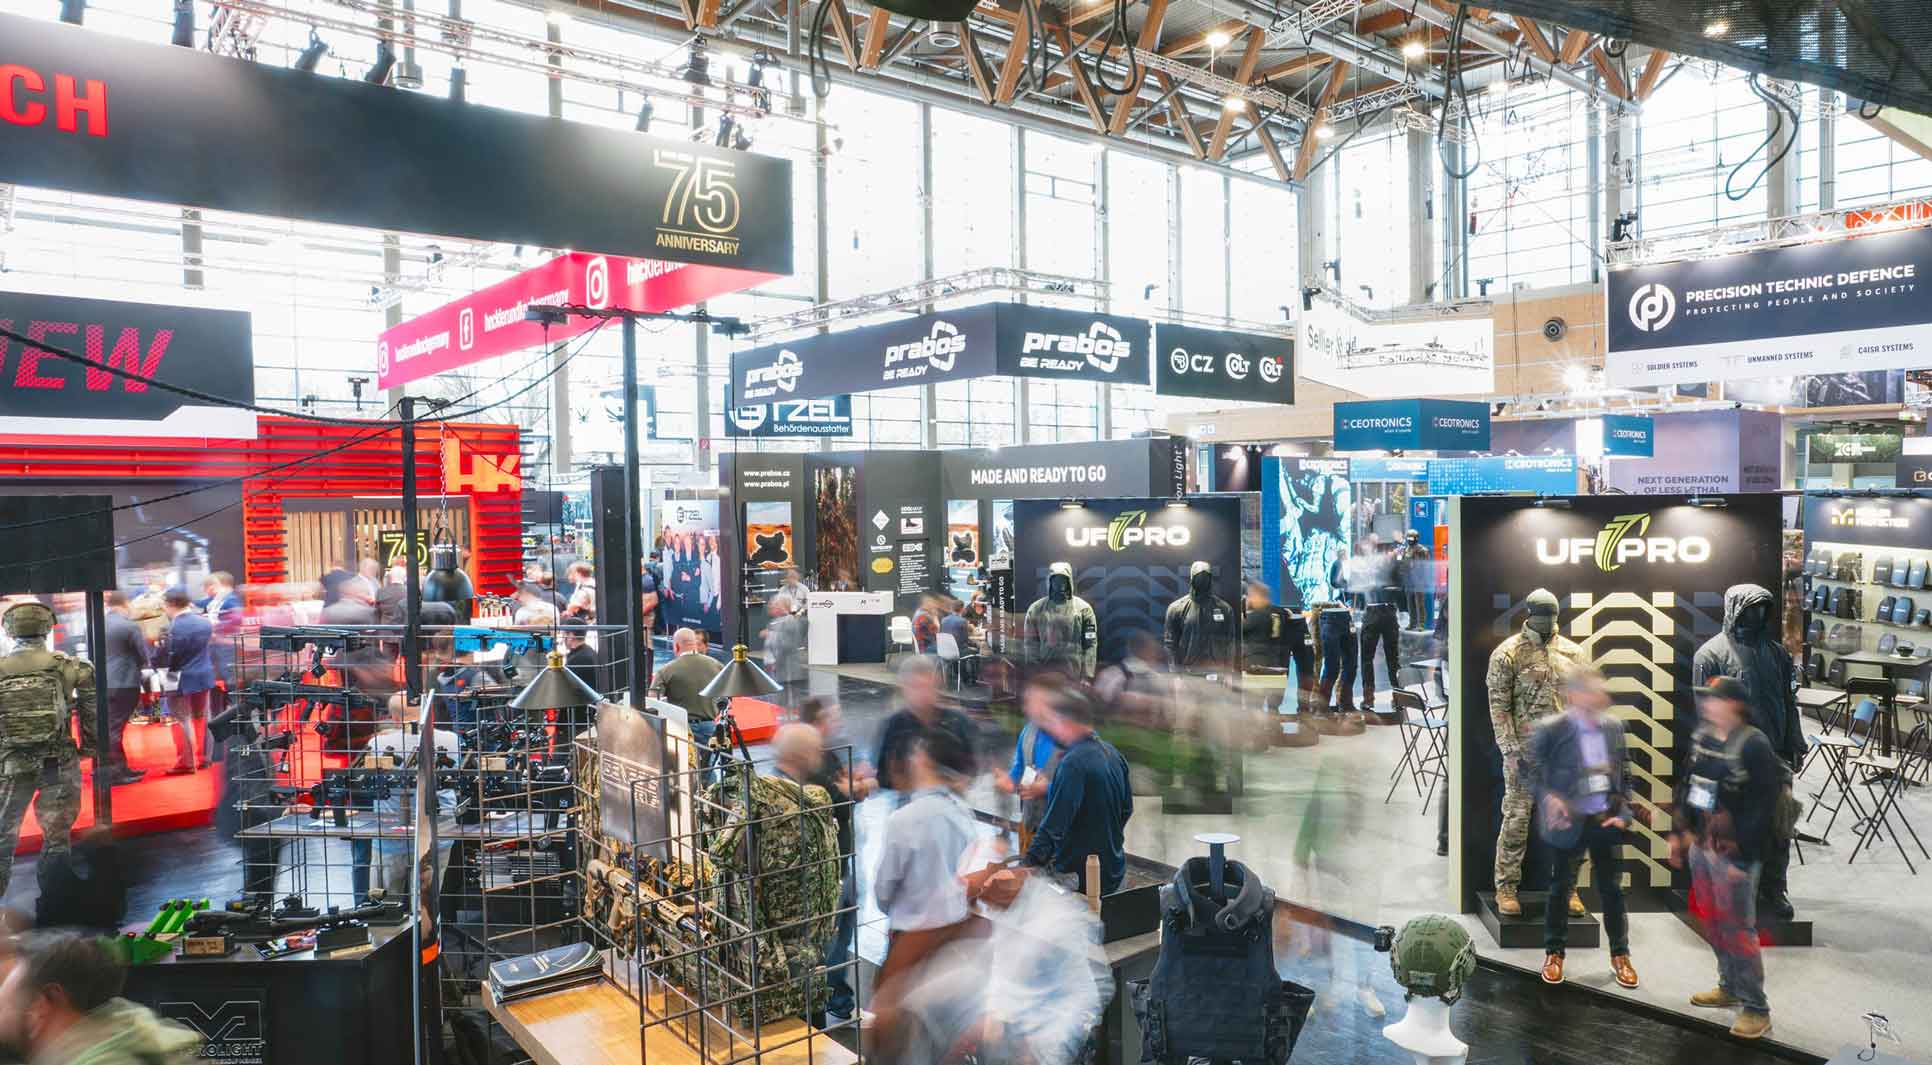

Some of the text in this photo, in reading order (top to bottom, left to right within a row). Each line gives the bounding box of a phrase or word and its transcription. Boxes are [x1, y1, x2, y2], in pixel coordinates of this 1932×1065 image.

[652, 150, 740, 233] 75
[656, 233, 740, 256] ANNIVERSARY
[1686, 264, 1915, 303] PRECISION TECHNIC DEFENCE
[1686, 284, 1914, 316] PROTECTING PEOPLE AND SOCIETY
[884, 334, 967, 367] prabos
[1022, 331, 1131, 357] prabos
[1881, 343, 1914, 352] SYSTEMS
[1019, 357, 1084, 371] BE READY
[1191, 355, 1214, 373] CZ
[1784, 351, 1813, 361] SYSTEMS
[746, 360, 804, 387] prabos
[882, 365, 928, 380] BE READY
[774, 423, 849, 433] Behördenausstatter
[1350, 417, 1412, 429] CEOTRONICS
[1439, 418, 1480, 429] CEOTRONICS
[971, 466, 1106, 484] MADE AND READY TO GO
[1638, 475, 1729, 484] NEXT GENERATION
[1643, 486, 1657, 494] OF
[1660, 486, 1684, 494] LESS
[1065, 526, 1191, 546] UF PRO
[1535, 536, 1711, 564] UF PRO
